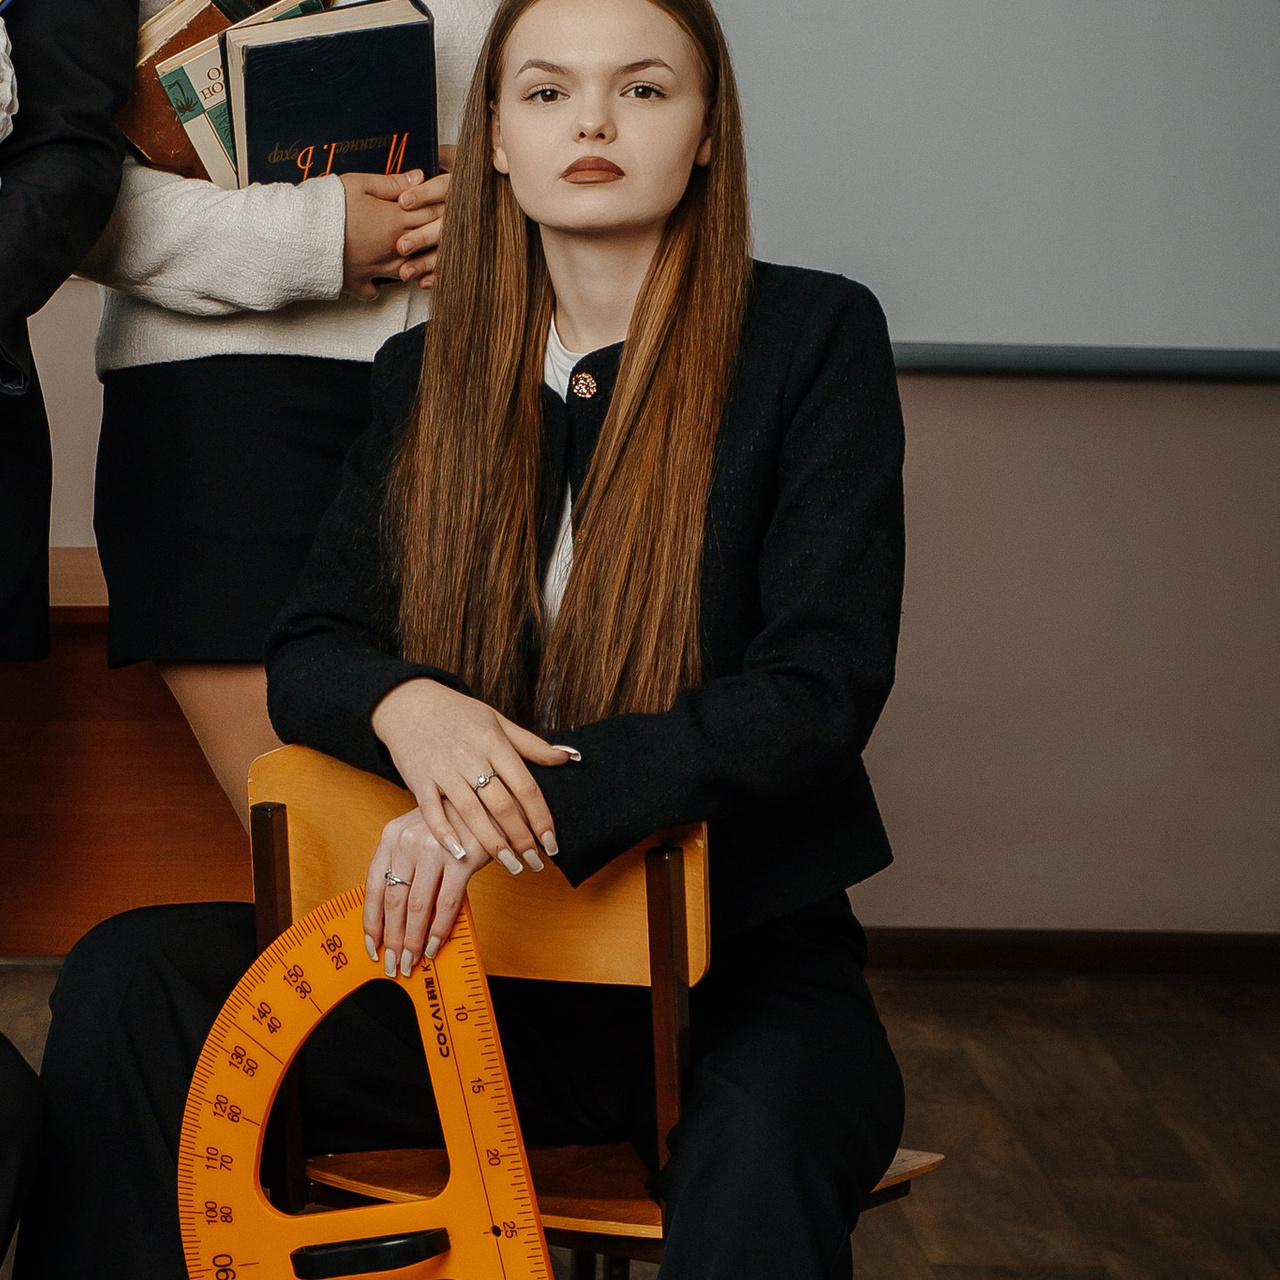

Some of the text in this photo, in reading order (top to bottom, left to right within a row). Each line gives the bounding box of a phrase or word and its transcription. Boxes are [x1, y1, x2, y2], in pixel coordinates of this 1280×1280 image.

[320, 934, 343, 956] 160
[331, 951, 349, 970] 20
[282, 964, 304, 987] 150
[295, 980, 313, 1000] 30
[251, 1001, 273, 1026] 140
[454, 1004, 469, 1022] 10
[266, 1016, 282, 1035] 40
[228, 1045, 247, 1070] 130
[242, 1058, 259, 1078] 50
[470, 1076, 485, 1095] 15
[212, 1094, 229, 1119] 120
[227, 1104, 242, 1124] 60
[204, 1146, 219, 1171] 110
[220, 1154, 234, 1172] 70
[486, 1148, 501, 1166] 20
[204, 1200, 219, 1225] 100
[220, 1206, 234, 1224] 80
[502, 1220, 518, 1239] 25
